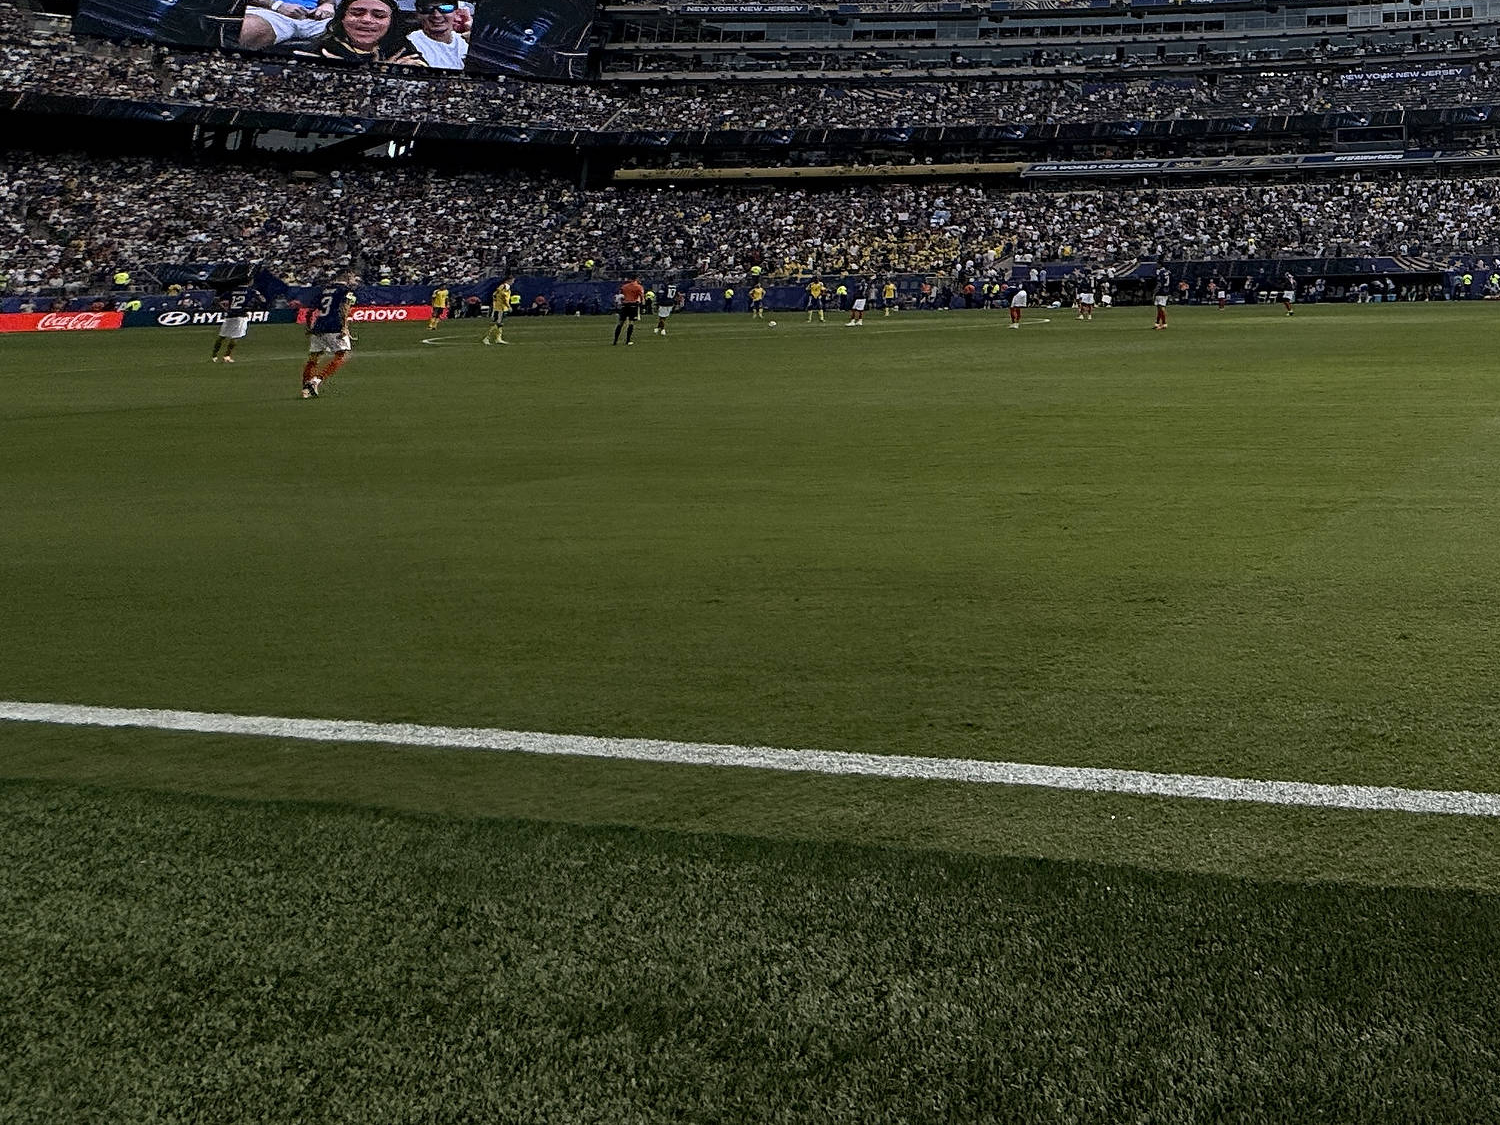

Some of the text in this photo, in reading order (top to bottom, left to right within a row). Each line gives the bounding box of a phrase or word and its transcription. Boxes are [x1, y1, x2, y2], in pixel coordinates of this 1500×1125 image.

[1366, 72, 1394, 80] YORK
[1421, 68, 1463, 77] JERSEY
[231, 295, 245, 309] 12
[689, 292, 712, 302] FIFA
[320, 296, 333, 316] 3
[37, 312, 104, 330] Coca-Cola
[192, 311, 270, 324] HYUAI
[347, 309, 407, 321] enovo
